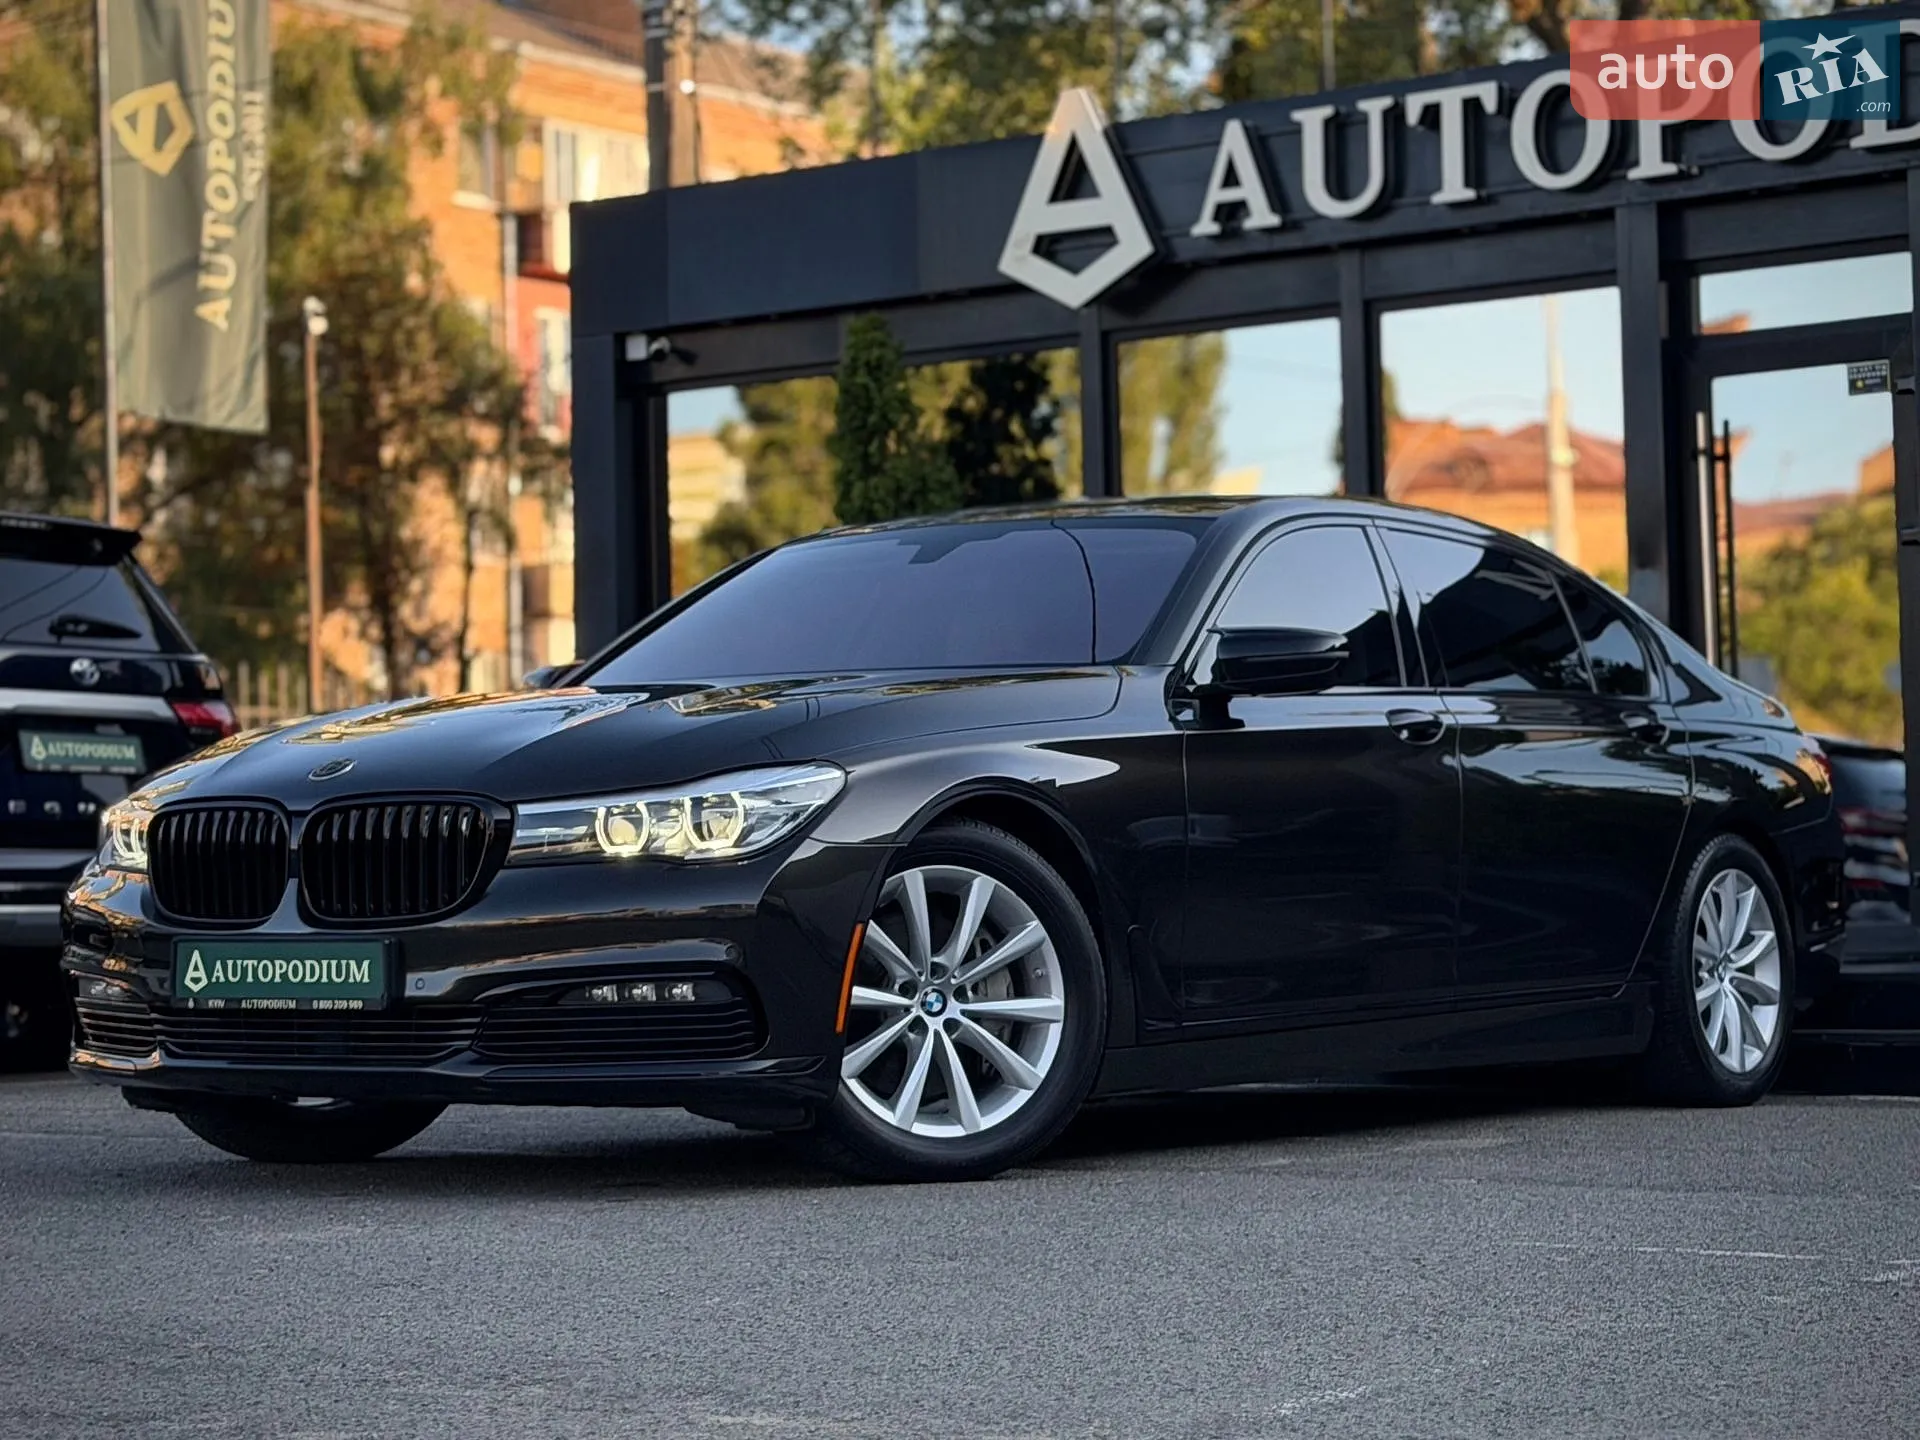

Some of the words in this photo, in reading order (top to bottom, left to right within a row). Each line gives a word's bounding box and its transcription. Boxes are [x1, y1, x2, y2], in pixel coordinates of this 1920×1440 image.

[47, 742, 137, 760] AUTOPODIUM
[211, 959, 371, 984] AUTOPODIUM
[241, 999, 297, 1010] AUTOPODIUM
